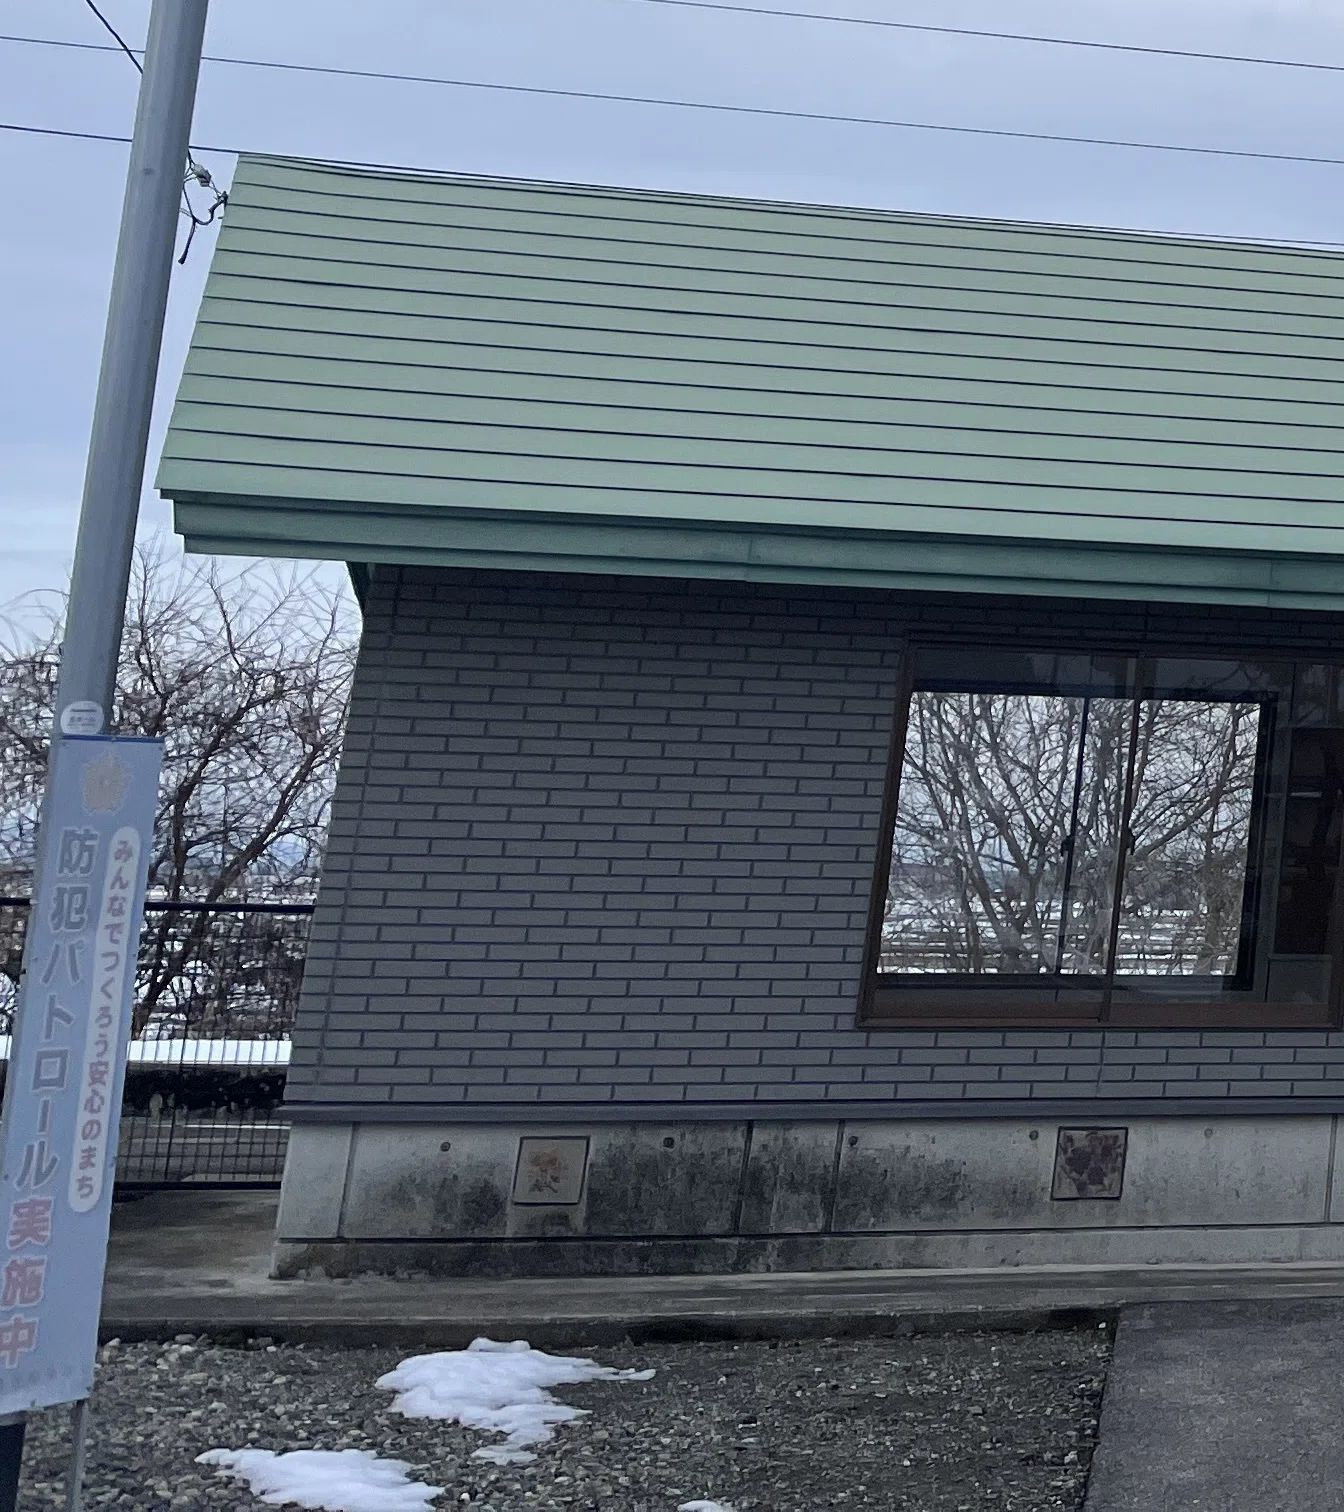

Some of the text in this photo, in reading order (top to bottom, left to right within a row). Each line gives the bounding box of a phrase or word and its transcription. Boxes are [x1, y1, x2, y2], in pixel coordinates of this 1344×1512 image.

[0, 828, 99, 1367] 防犯パトロール実施中
[76, 839, 134, 1200] みんなでつくろう安心のまち
